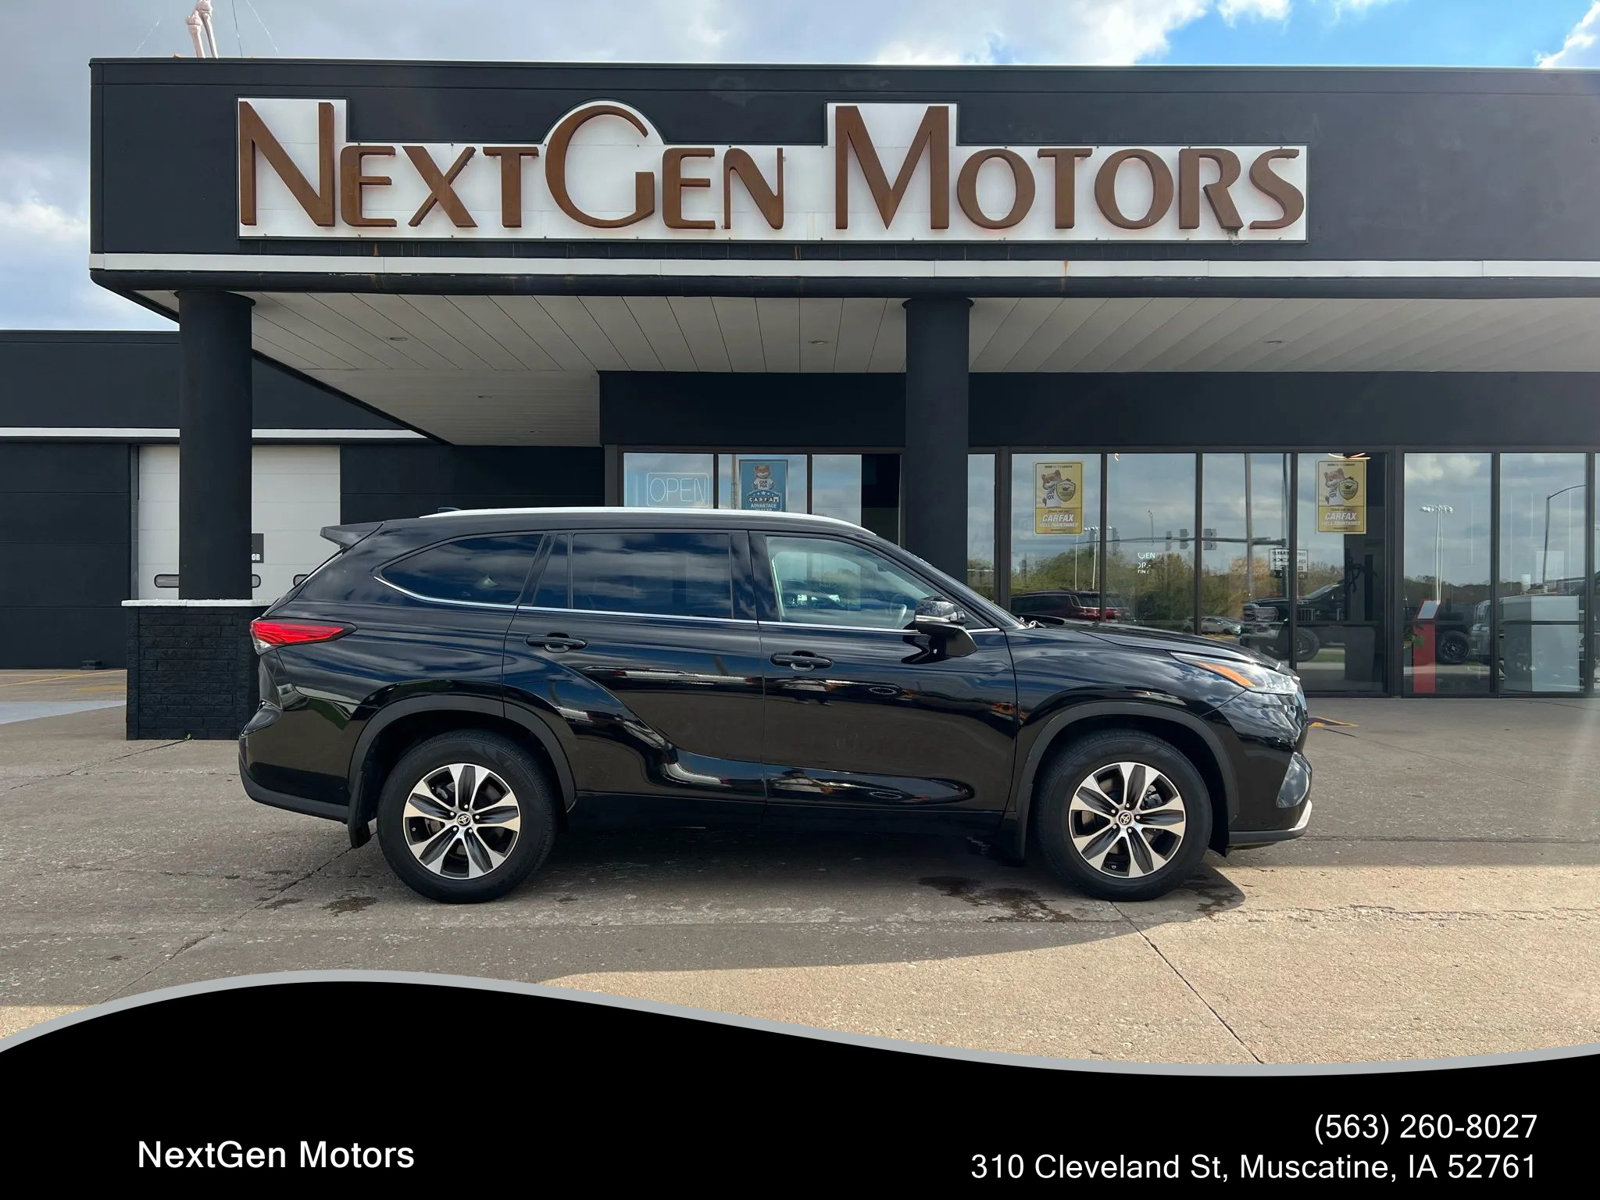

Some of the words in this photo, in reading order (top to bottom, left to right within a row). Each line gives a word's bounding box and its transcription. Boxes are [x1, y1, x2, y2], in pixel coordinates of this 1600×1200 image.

[835, 105, 1304, 230] MOTORS
[650, 478, 706, 502] OPEN
[1042, 514, 1074, 522] CARFAX
[1325, 512, 1357, 520] CARFAX
